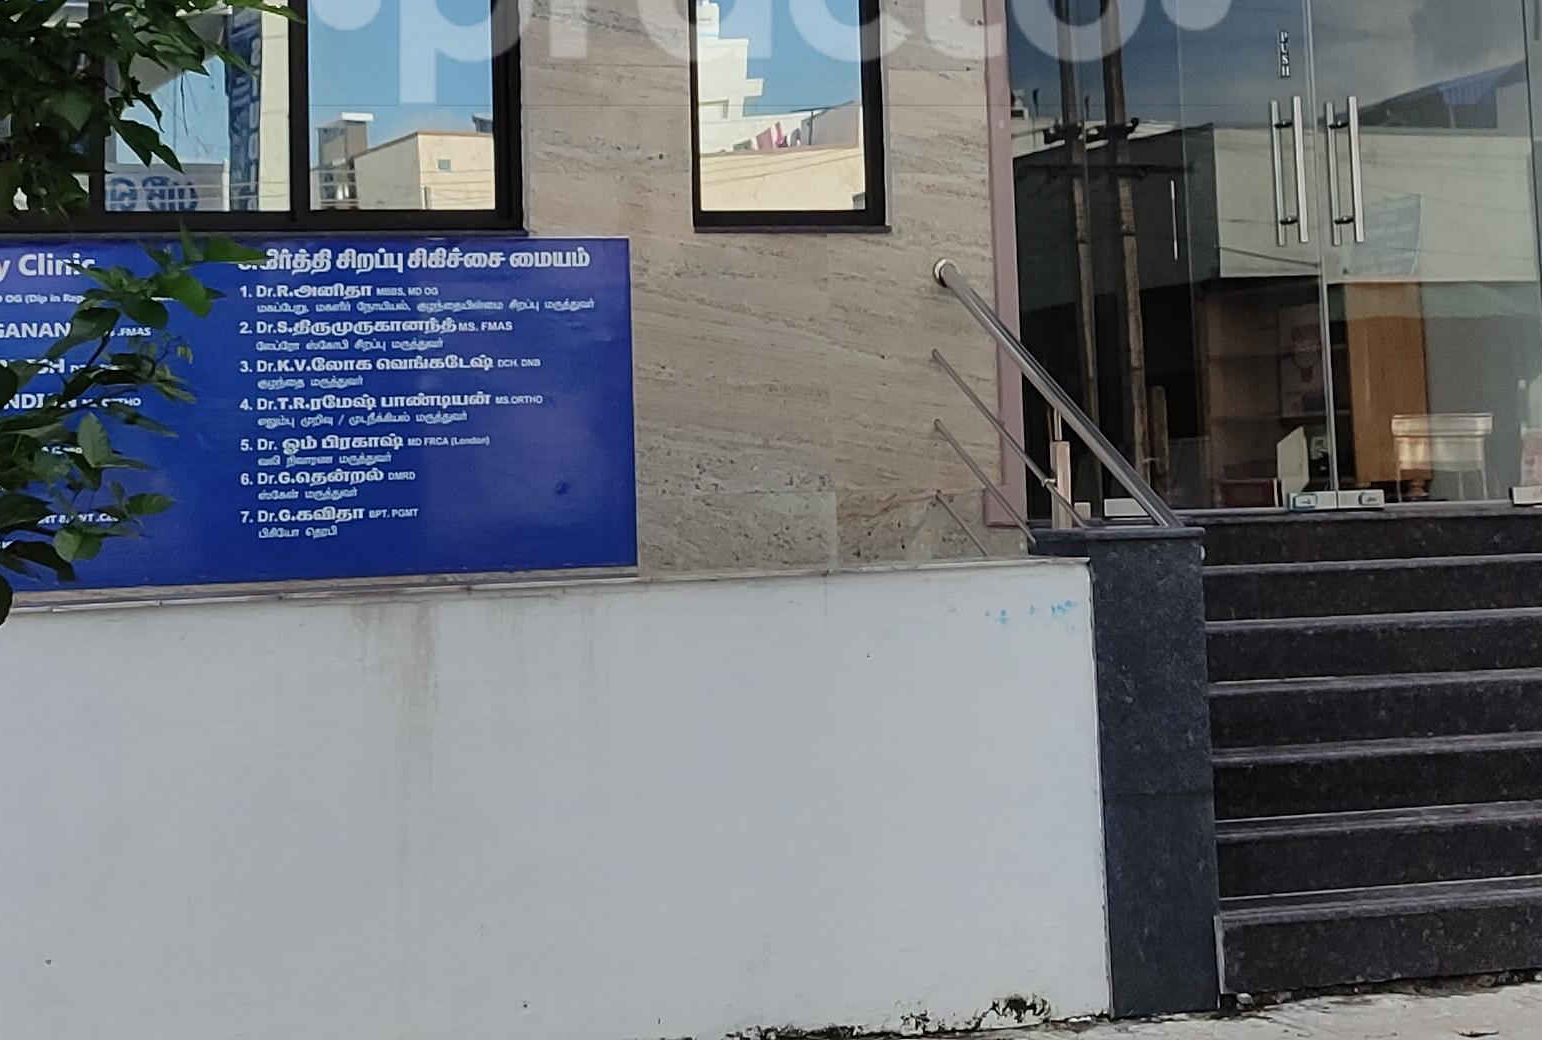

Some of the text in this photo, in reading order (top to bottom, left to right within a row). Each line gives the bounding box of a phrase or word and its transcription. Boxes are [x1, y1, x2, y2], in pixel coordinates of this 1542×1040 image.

[1280, 31, 1291, 77] PUSH
[336, 247, 404, 274] சிறப்பு
[407, 246, 506, 269] சிகிச்சை
[509, 246, 591, 268] மையம்
[6, 293, 22, 303] OG
[63, 292, 86, 304] Rep
[240, 285, 253, 298] 1.
[408, 287, 422, 295] MD
[424, 286, 439, 295] OG
[239, 321, 253, 334] 2.
[481, 321, 513, 331] FMAS
[239, 360, 253, 373] 3.
[239, 397, 253, 410] 4.
[240, 438, 253, 451] 5.
[257, 438, 278, 451] Dr.
[240, 472, 253, 485] 6.
[240, 510, 254, 523] 7.
